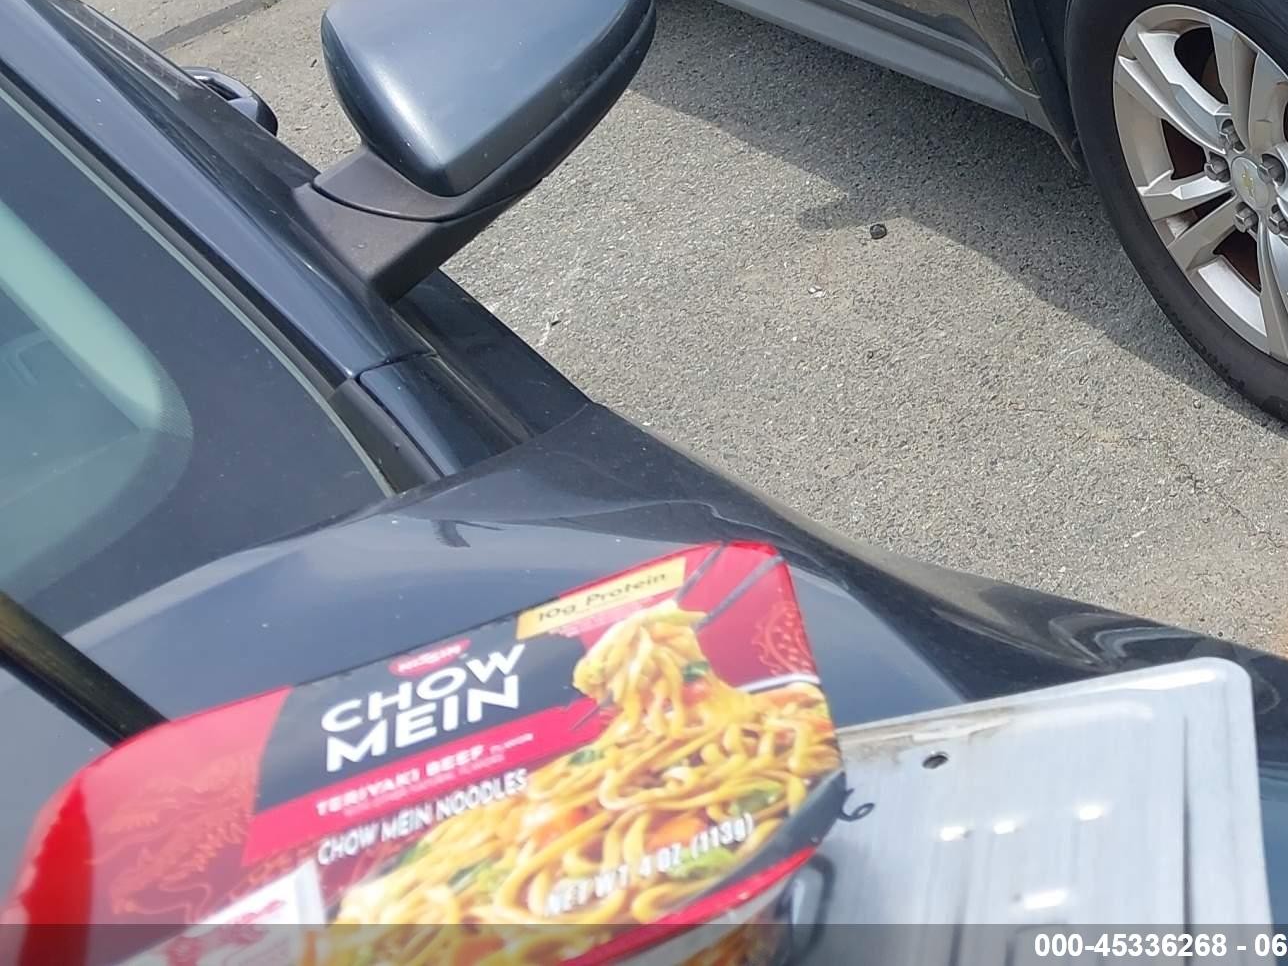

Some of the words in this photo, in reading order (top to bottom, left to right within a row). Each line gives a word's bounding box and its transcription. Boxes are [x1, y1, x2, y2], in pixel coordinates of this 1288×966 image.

[539, 604, 577, 622] 10g
[586, 572, 666, 606] Protein
[321, 643, 526, 733] CHOW
[326, 674, 520, 772] MEIN
[316, 767, 421, 817] TERIYAKI
[426, 745, 485, 777] BEEF
[317, 821, 380, 865] CHOW
[381, 801, 434, 842] MEIN
[435, 767, 528, 822] NOODLES
[546, 879, 593, 917] NET
[639, 854, 653, 878] 4
